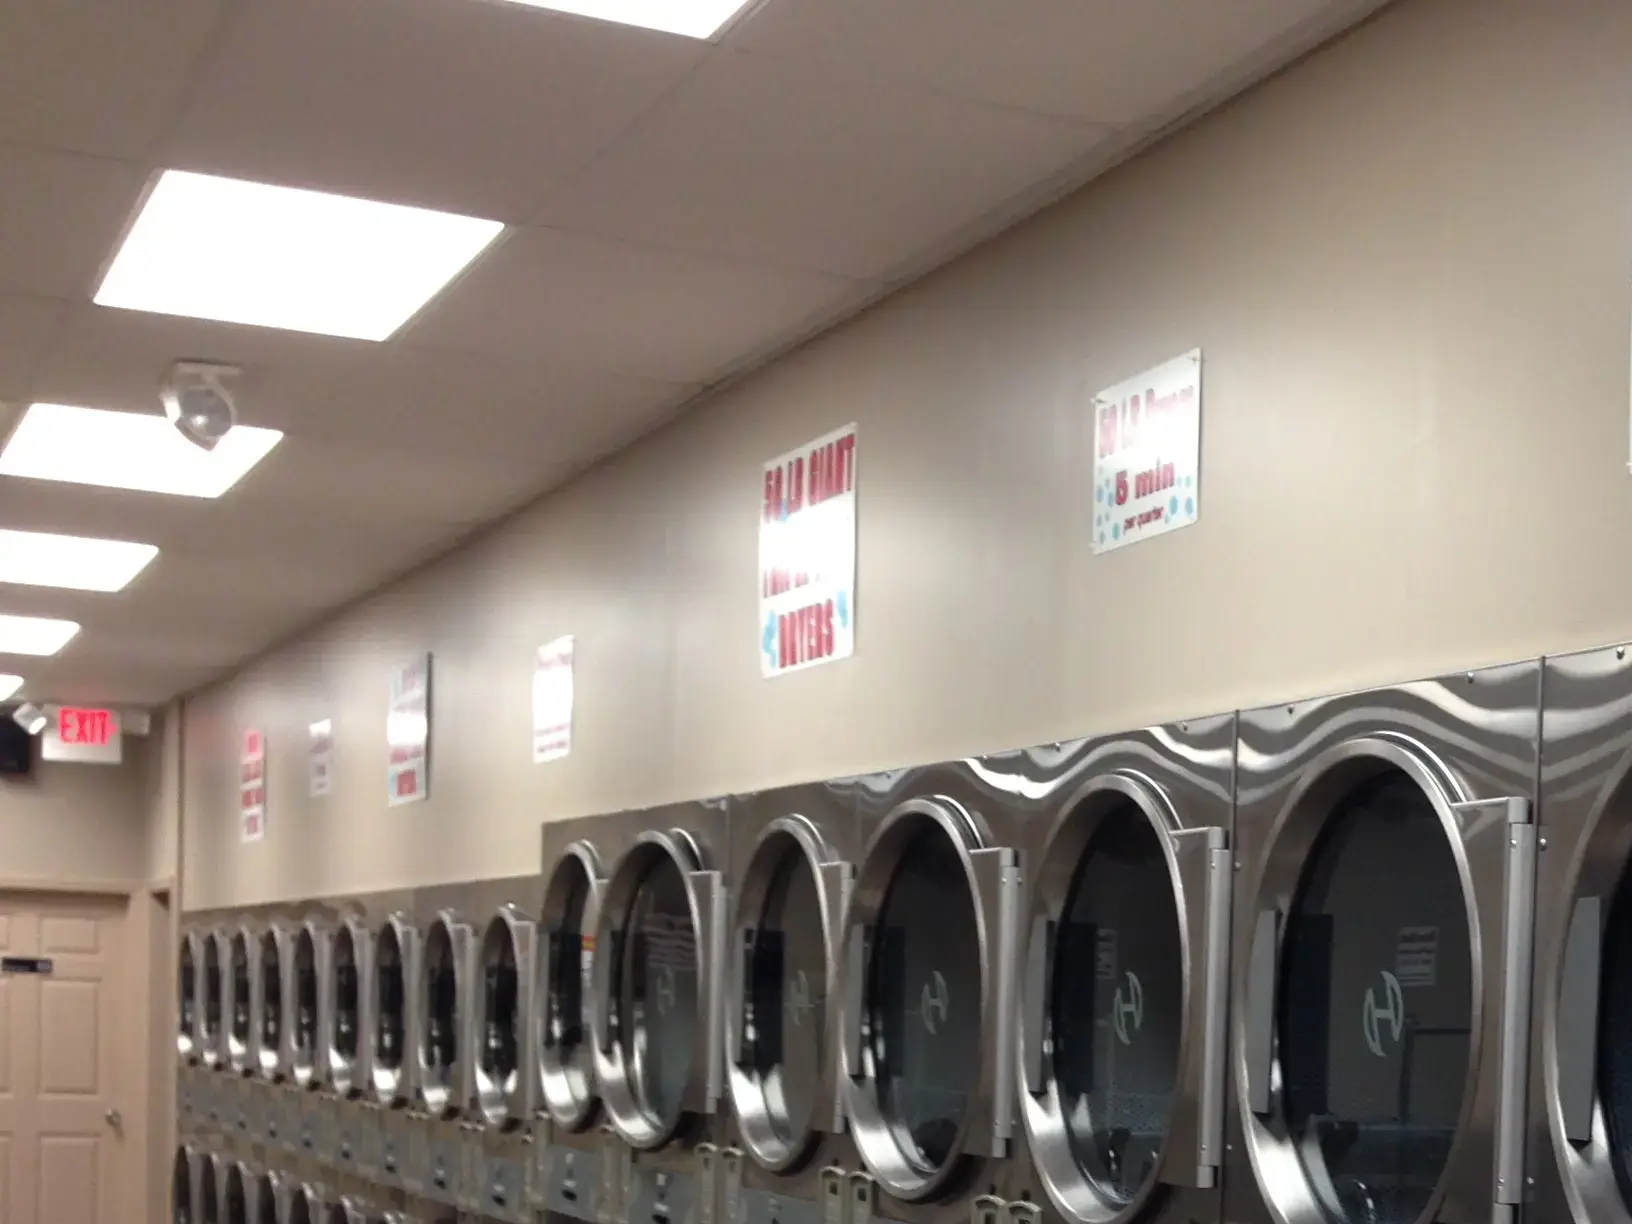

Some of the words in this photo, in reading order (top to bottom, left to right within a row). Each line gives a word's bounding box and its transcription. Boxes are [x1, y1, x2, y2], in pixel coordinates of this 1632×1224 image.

[1134, 456, 1175, 500] min
[60, 707, 109, 745] EXIT
[1362, 970, 1404, 1058] H
